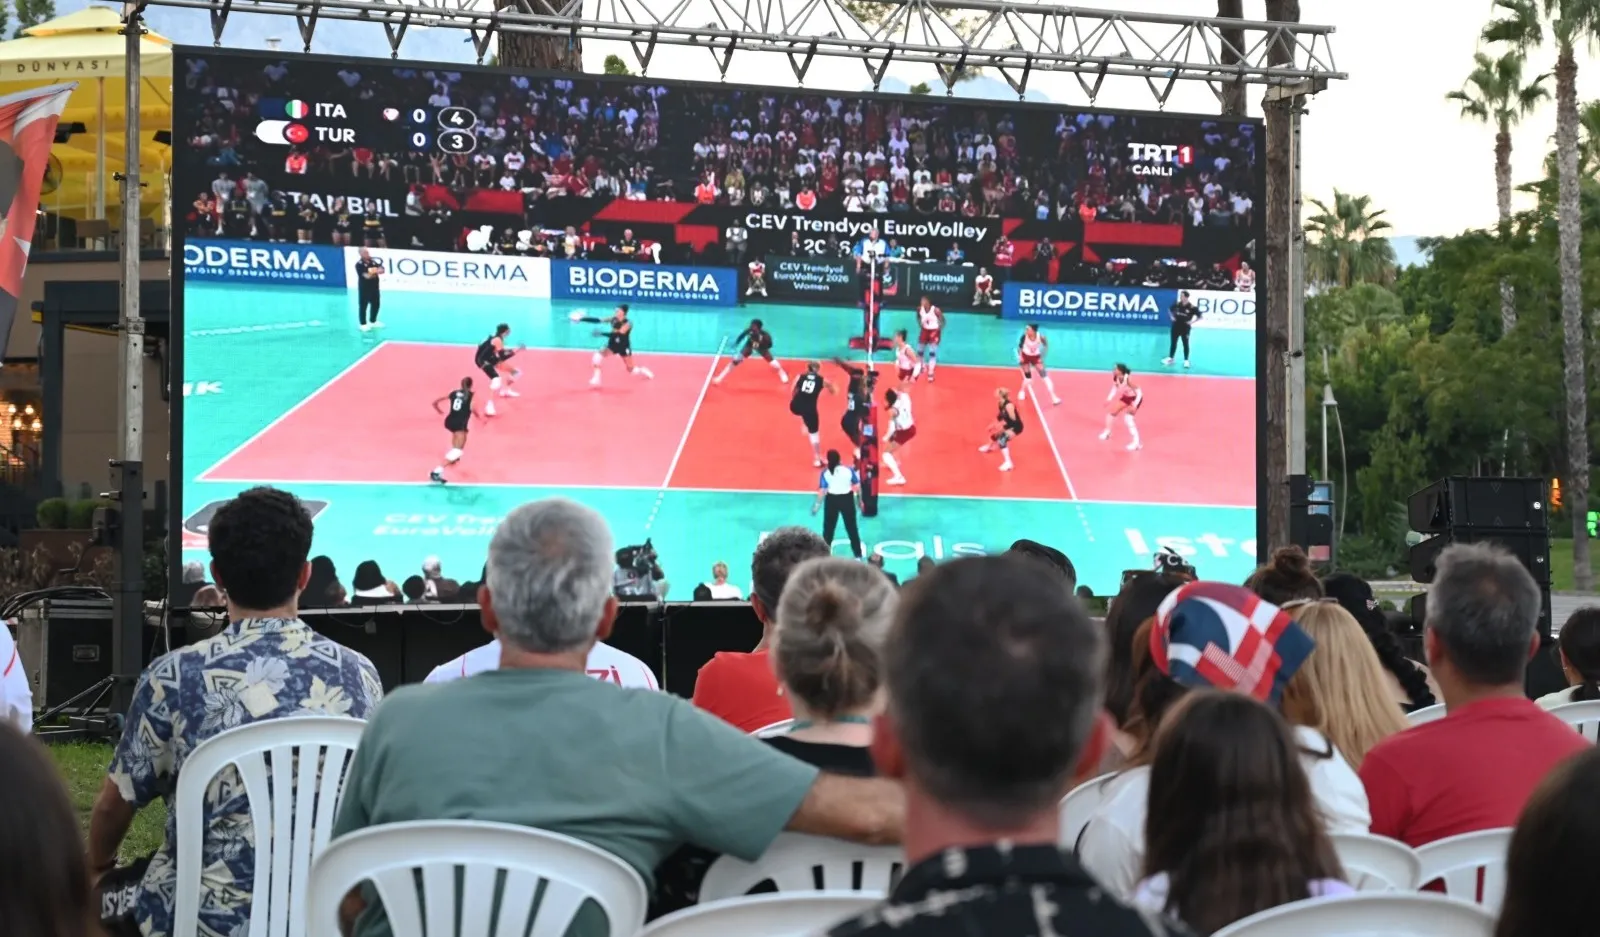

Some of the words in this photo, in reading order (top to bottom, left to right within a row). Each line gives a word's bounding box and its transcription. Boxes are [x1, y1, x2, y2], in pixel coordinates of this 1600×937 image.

[17, 60, 109, 73] DÜNYASI
[315, 102, 347, 118] ITA
[412, 109, 426, 123] 0
[450, 111, 464, 125] 4
[315, 127, 356, 143] TUR
[412, 132, 426, 147] 0
[451, 135, 463, 148] 3
[1132, 164, 1173, 176] CANLI
[745, 213, 788, 230] CEV
[792, 215, 878, 237] Trendyol
[884, 219, 987, 242] EuroVolley
[780, 262, 800, 271] CEV
[802, 263, 843, 274] Trendyol
[569, 266, 719, 293] BIODERMA
[773, 271, 824, 283] EuroVolley
[826, 274, 849, 283] 2026
[919, 272, 964, 283] Istanbul
[793, 281, 830, 291] Women
[569, 287, 633, 297] LABORATOIRE
[637, 290, 720, 301] DERMATOLOGIQUE
[1019, 288, 1159, 313] BIODERMA
[1018, 308, 1077, 317] LABORATOIRE
[1081, 310, 1159, 320] DERMATOLOGIQUE
[801, 380, 816, 394] 19
